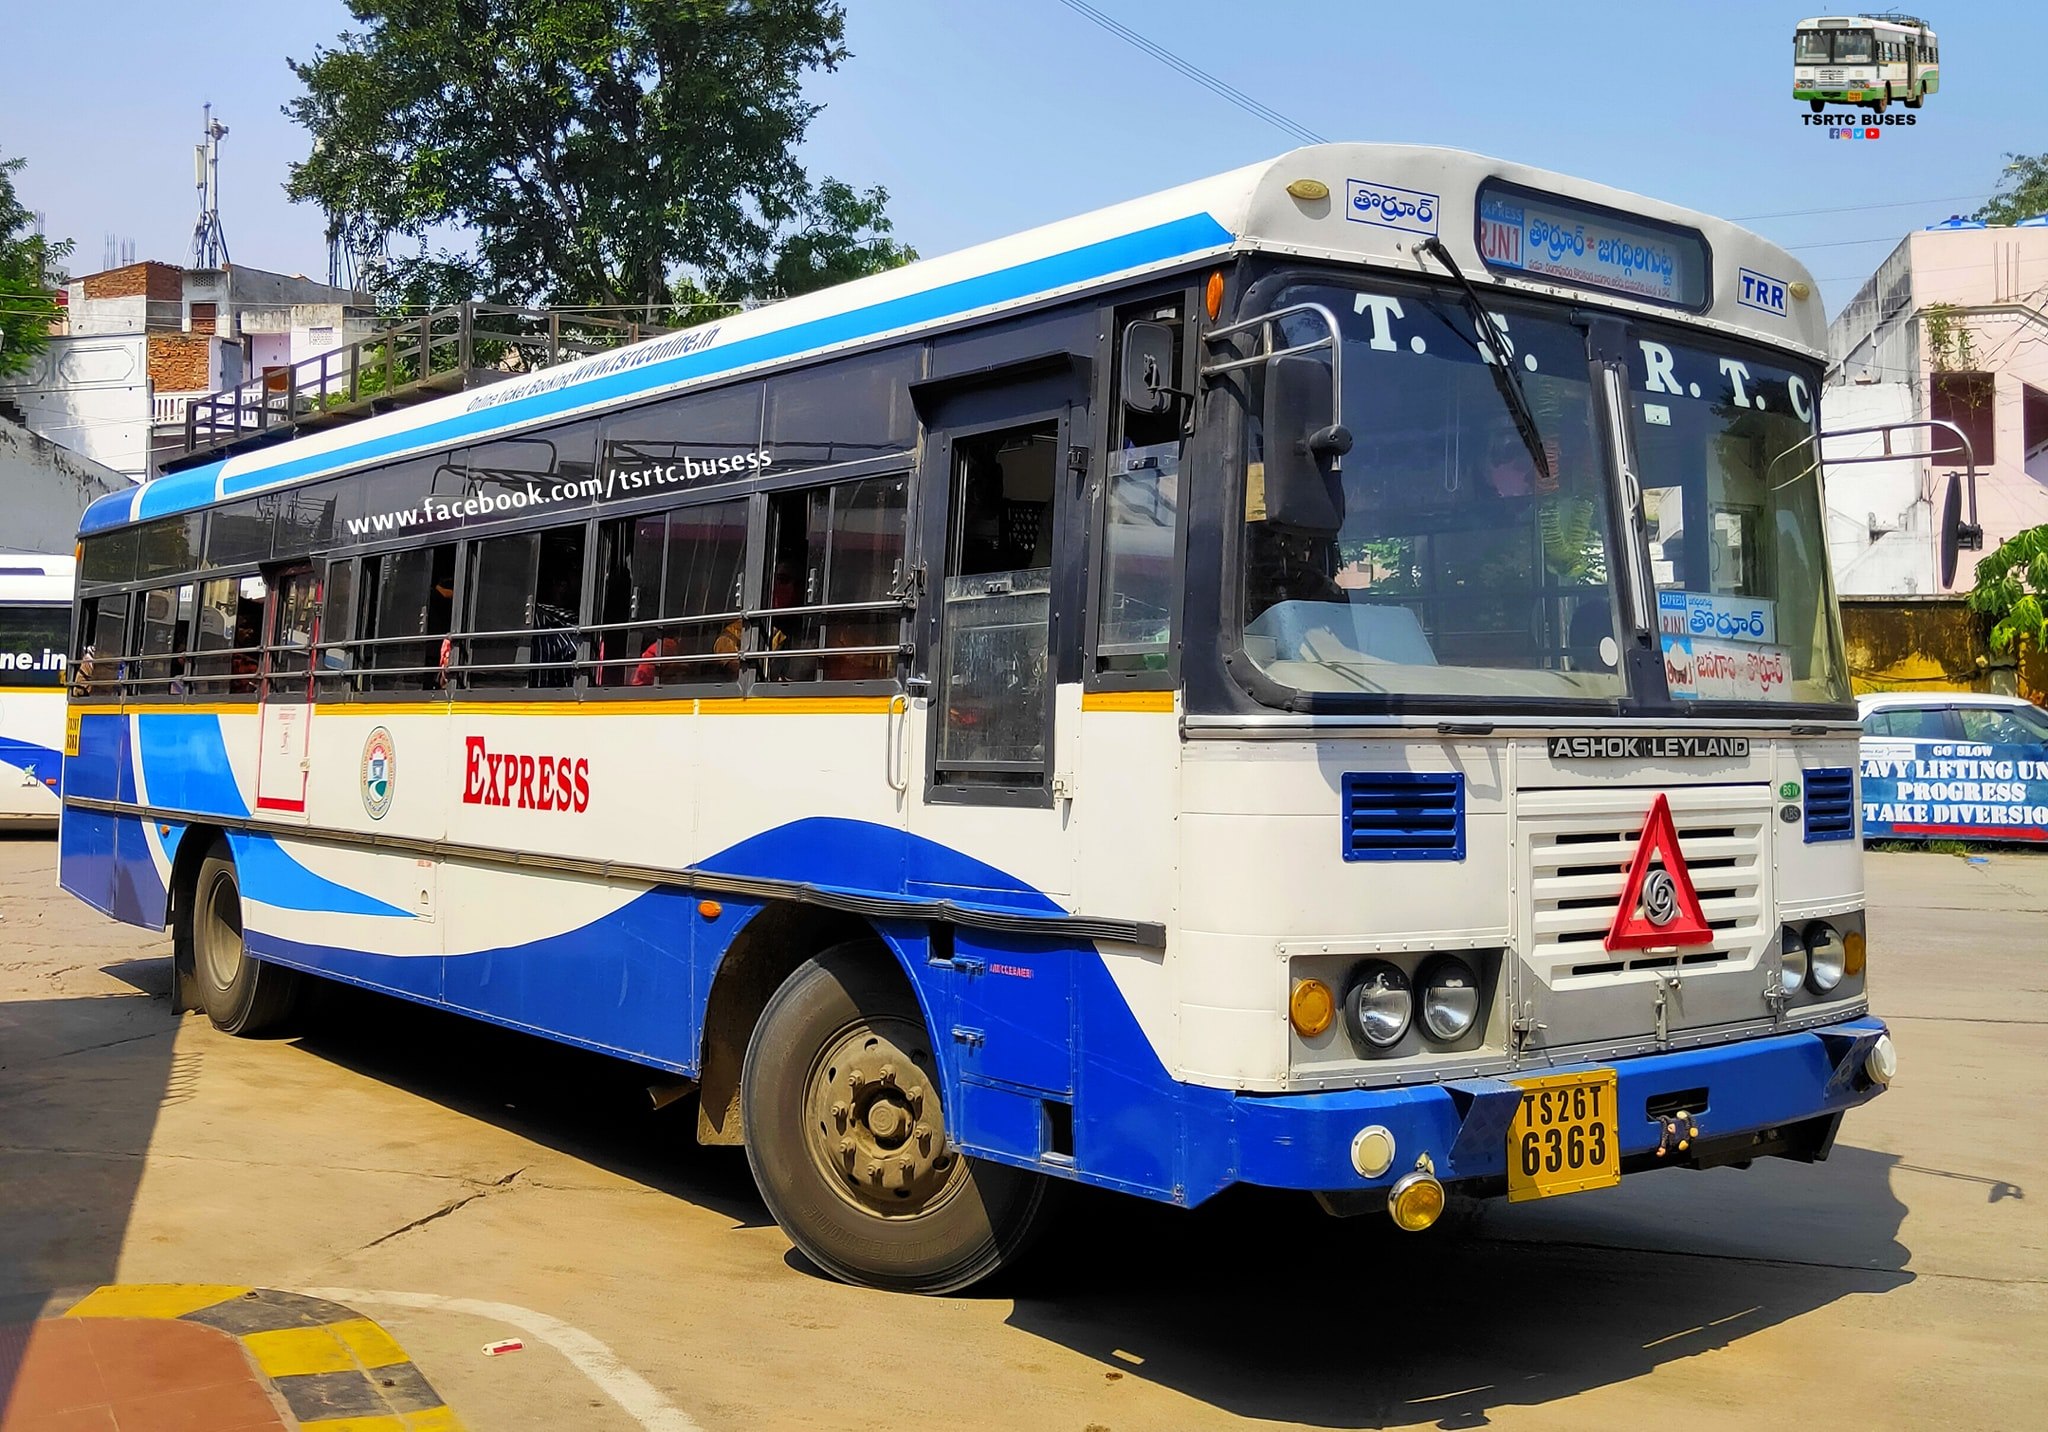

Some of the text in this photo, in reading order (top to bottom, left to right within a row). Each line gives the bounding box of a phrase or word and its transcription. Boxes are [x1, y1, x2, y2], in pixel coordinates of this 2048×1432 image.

[1353, 189, 1434, 222] తొర్రూర్
[1479, 201, 1523, 222] XPRESS
[1529, 218, 1585, 262] తొర్రూర్
[1742, 275, 1784, 310] TRR
[1552, 737, 1748, 759] ASHOK LEYLAND
[1932, 745, 1993, 757] GO SLOW
[462, 735, 590, 814] EXPRESS
[1914, 760, 2013, 780] LIFTING
[1896, 781, 2027, 803] PROGRESS
[1784, 807, 1798, 820] ABS
[1862, 803, 1928, 823] TAKE
[1523, 1085, 1602, 1128] TS26T
[1521, 1121, 1607, 1177] 6363
